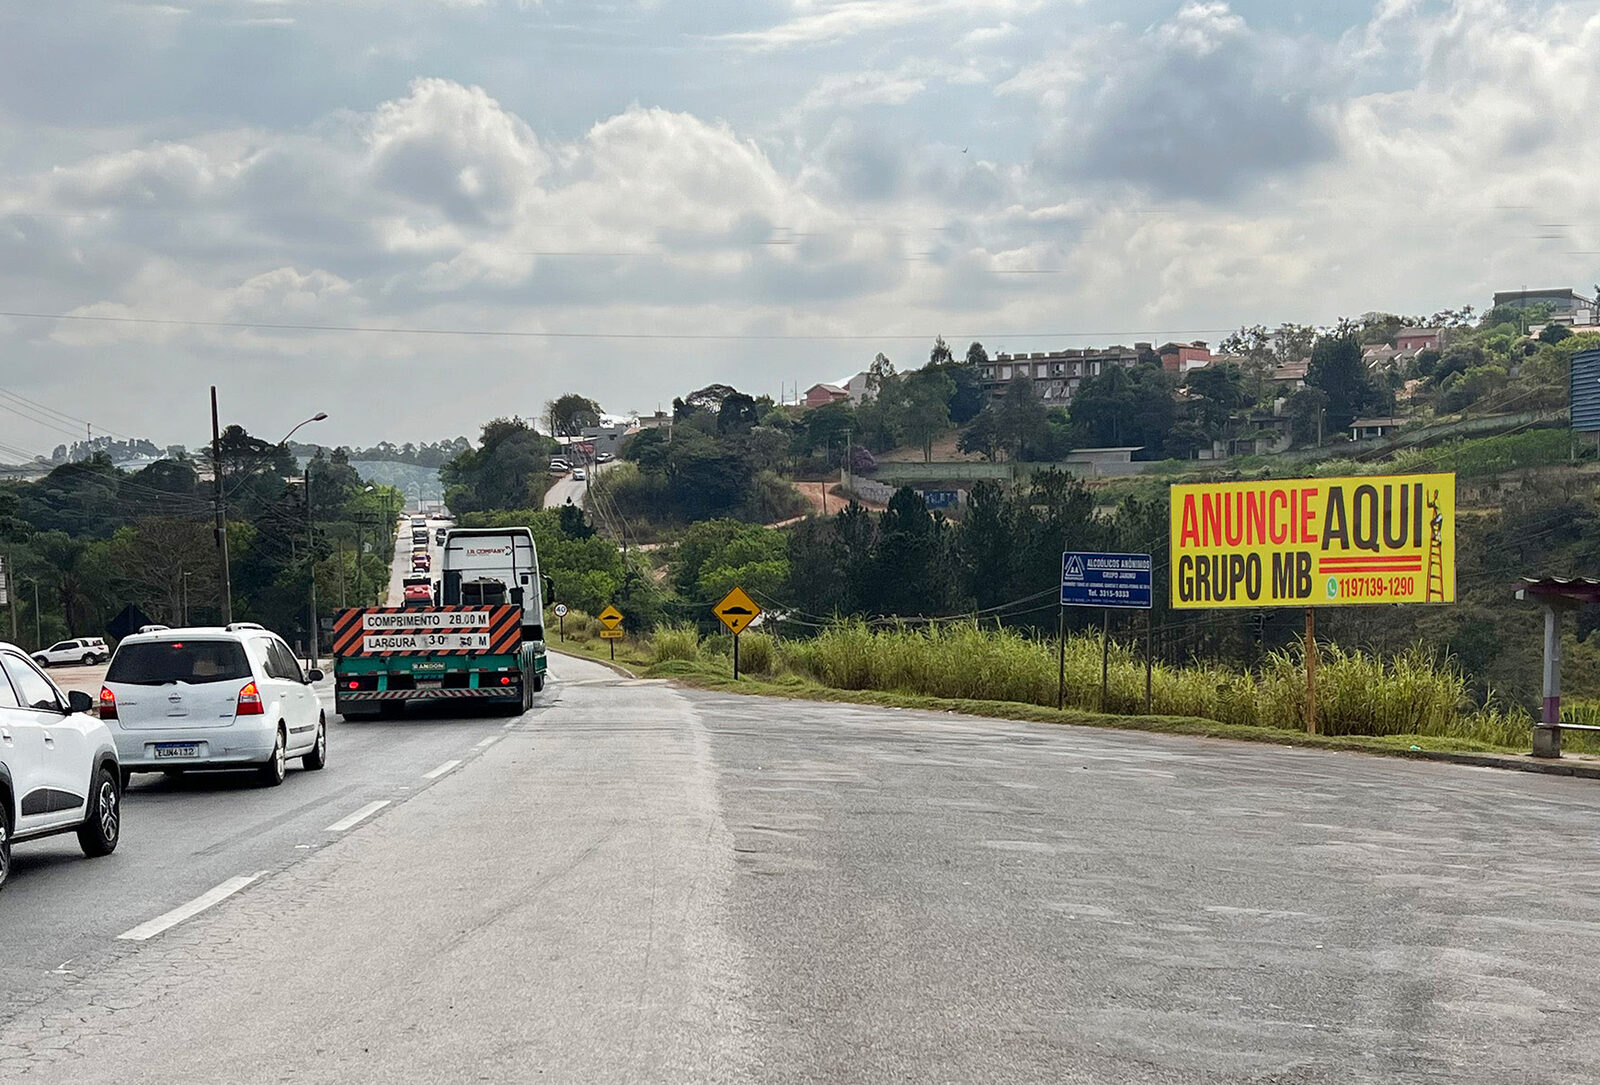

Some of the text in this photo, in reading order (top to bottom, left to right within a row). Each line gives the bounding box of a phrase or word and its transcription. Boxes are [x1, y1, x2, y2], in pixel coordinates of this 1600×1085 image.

[1180, 483, 1424, 552] ANUNCIE AQUI
[1178, 551, 1313, 602] GRUPO MB
[1339, 576, 1414, 598] 1197139-1290
[367, 615, 440, 627] COMPRIMENTO
[478, 614, 487, 625] M
[368, 637, 417, 649] LARGURA
[478, 636, 487, 646] M
